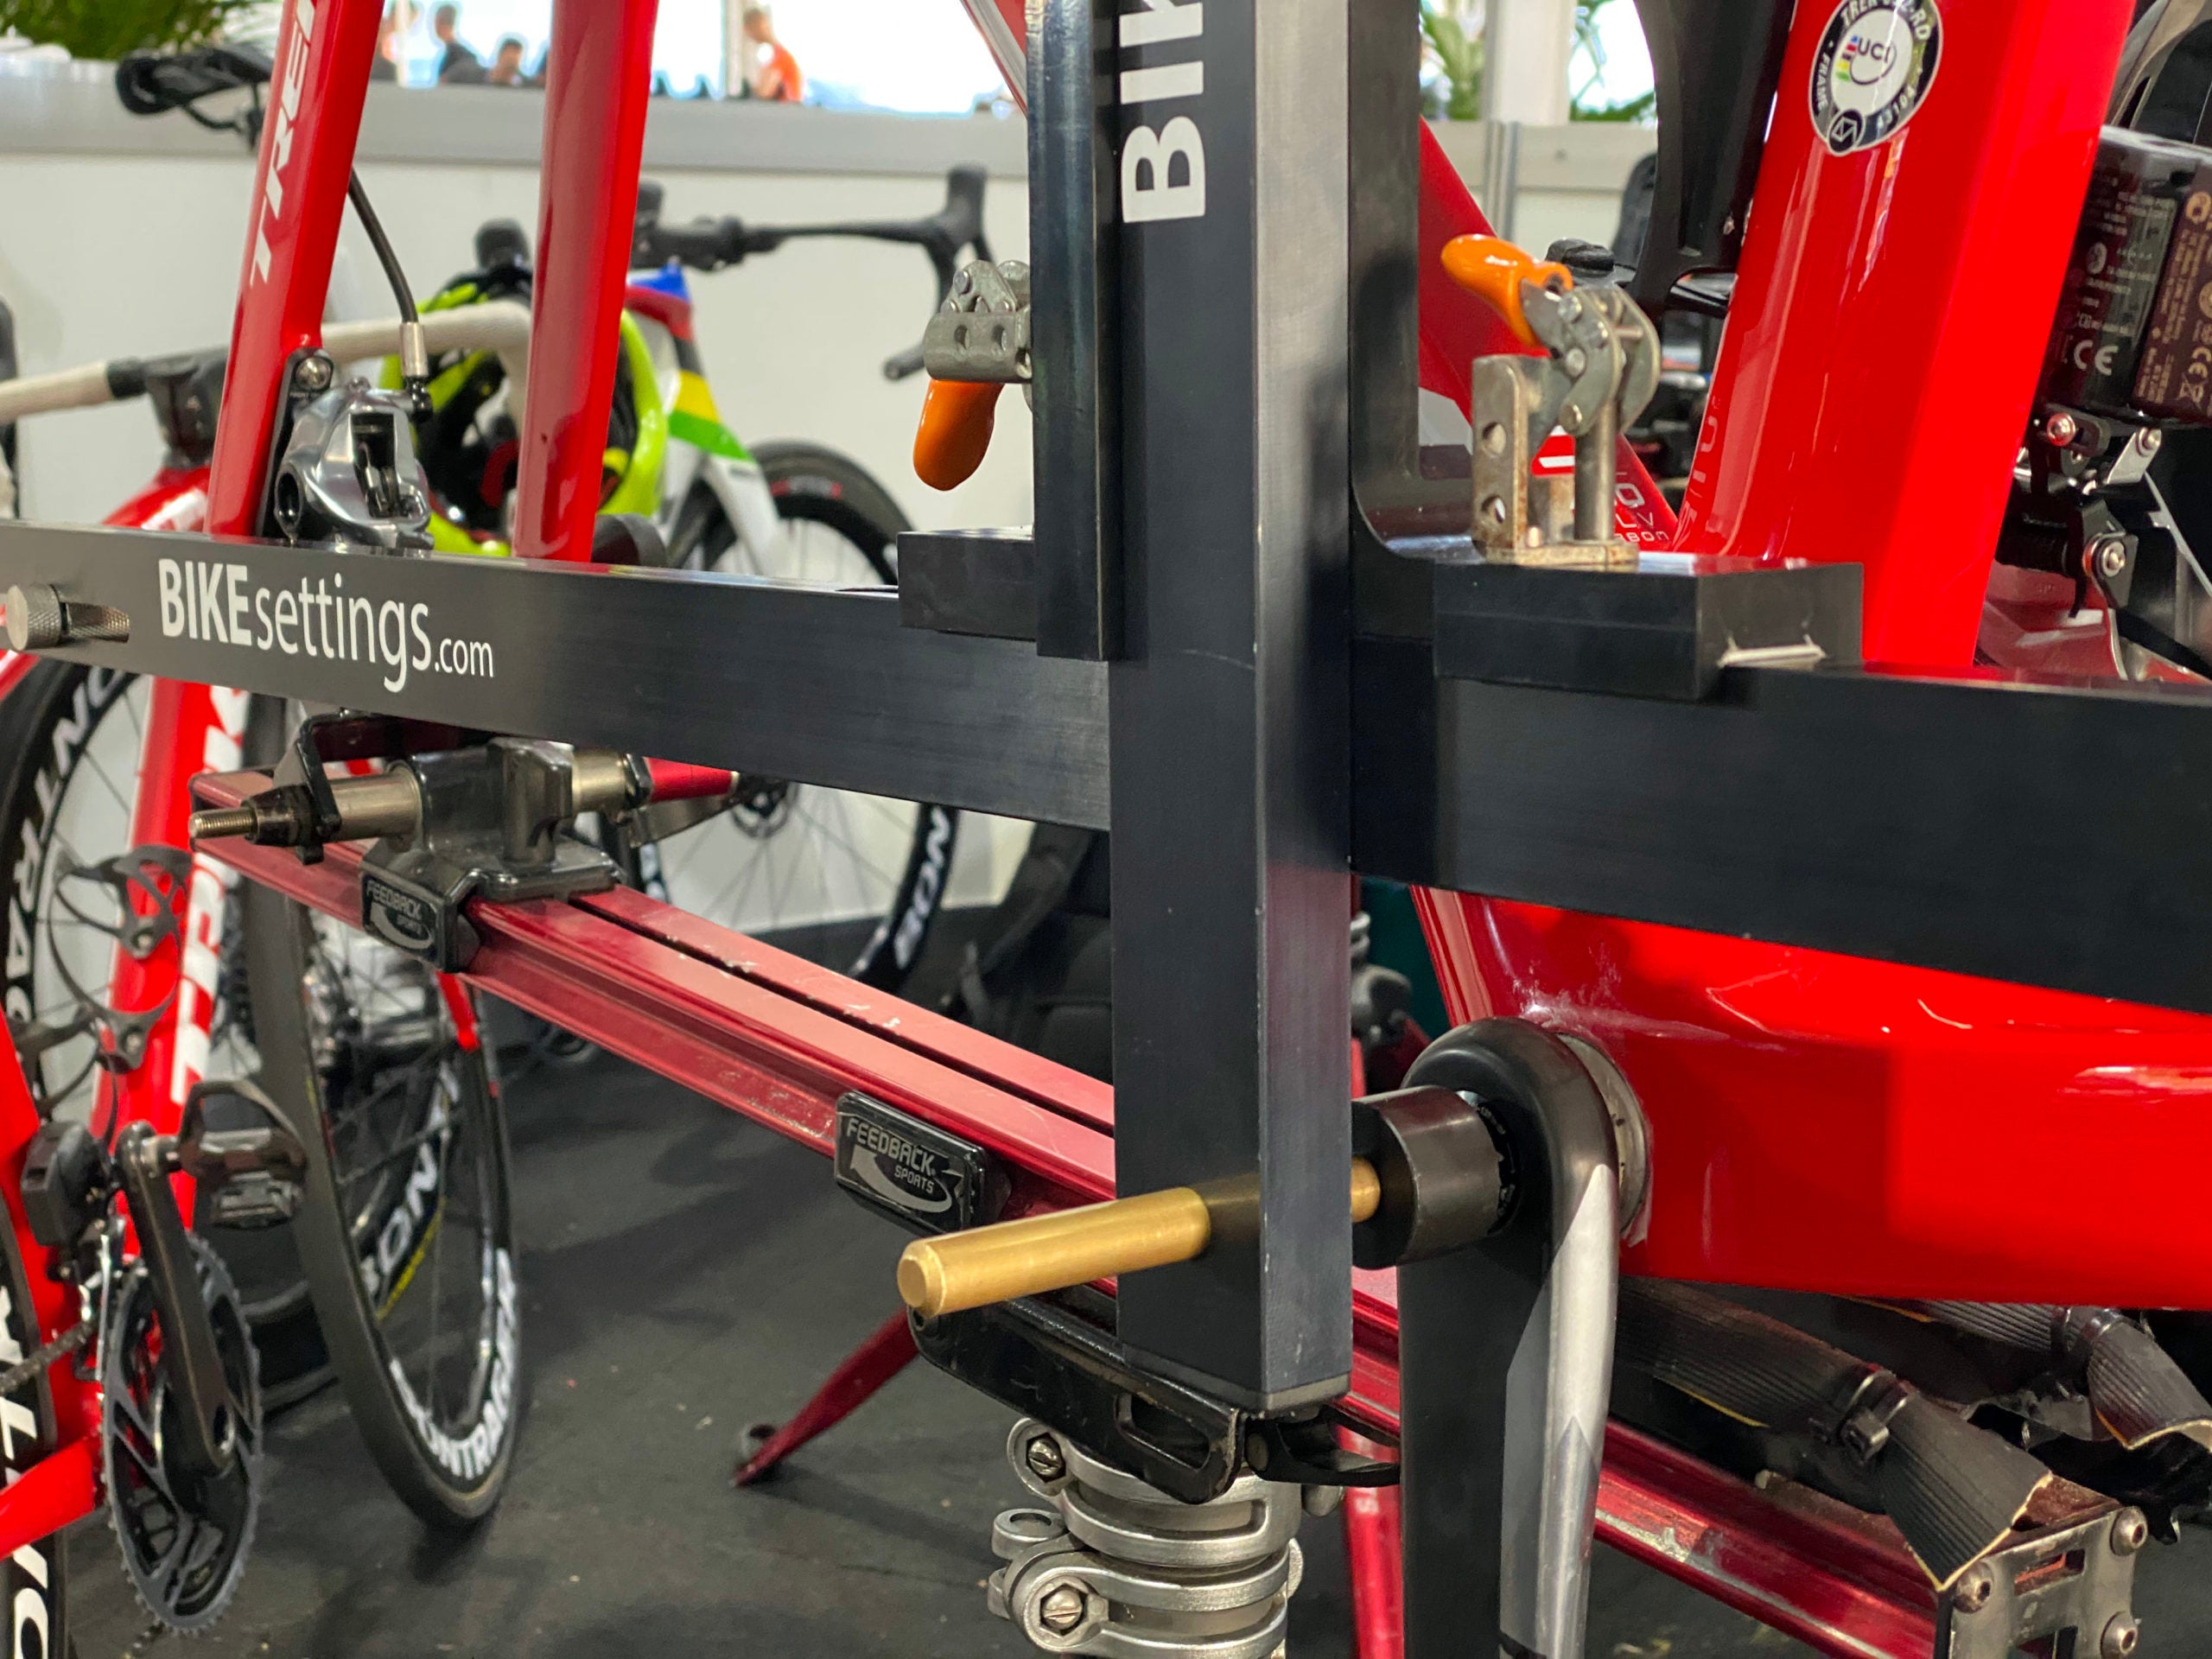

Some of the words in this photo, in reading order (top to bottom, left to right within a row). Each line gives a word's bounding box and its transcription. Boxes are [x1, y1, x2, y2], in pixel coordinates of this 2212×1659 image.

[1857, 38, 1891, 63] UCI
[158, 558, 494, 693] BIKEsettings.com
[846, 1118, 934, 1177] FEEDBACK
[893, 1164, 935, 1195] SPORTS
